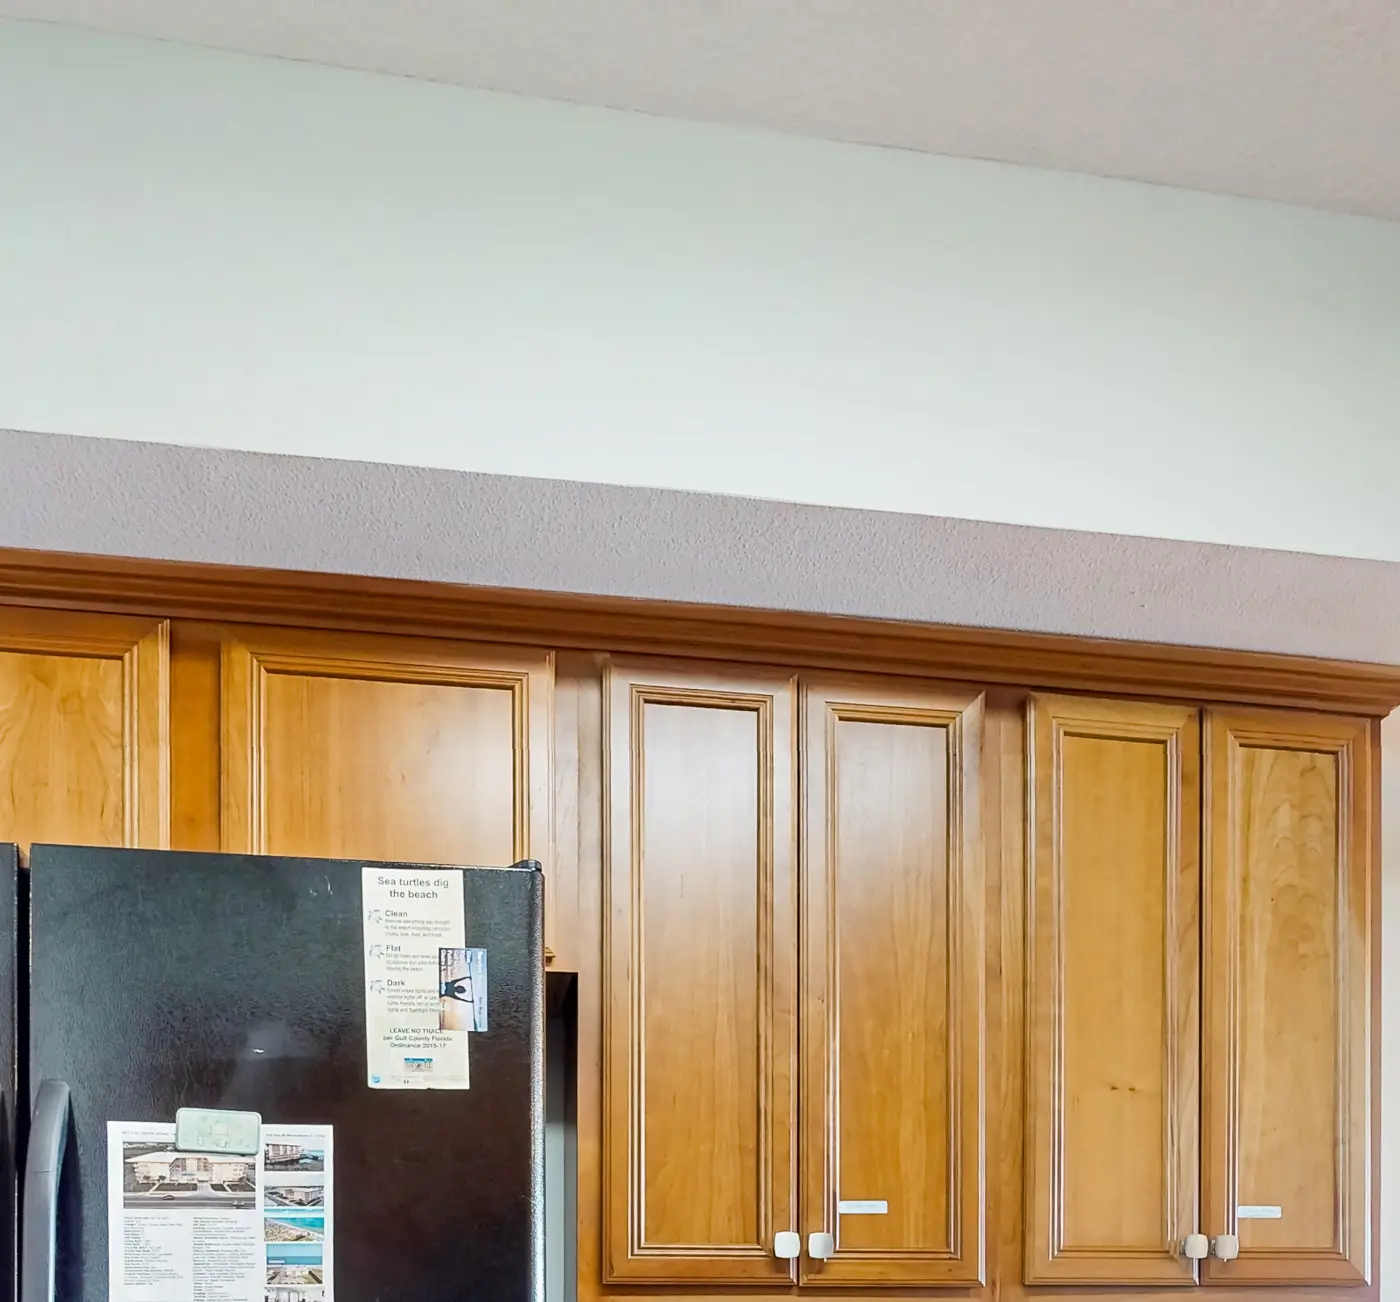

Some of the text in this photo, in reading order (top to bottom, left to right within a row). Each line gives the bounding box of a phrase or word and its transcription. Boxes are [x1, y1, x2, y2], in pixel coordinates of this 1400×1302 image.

[377, 876, 449, 888] Sea turtles dig
[389, 889, 438, 899] the beach
[384, 909, 408, 918] Clean
[387, 979, 406, 987] Dark
[408, 1035, 430, 1043] County
